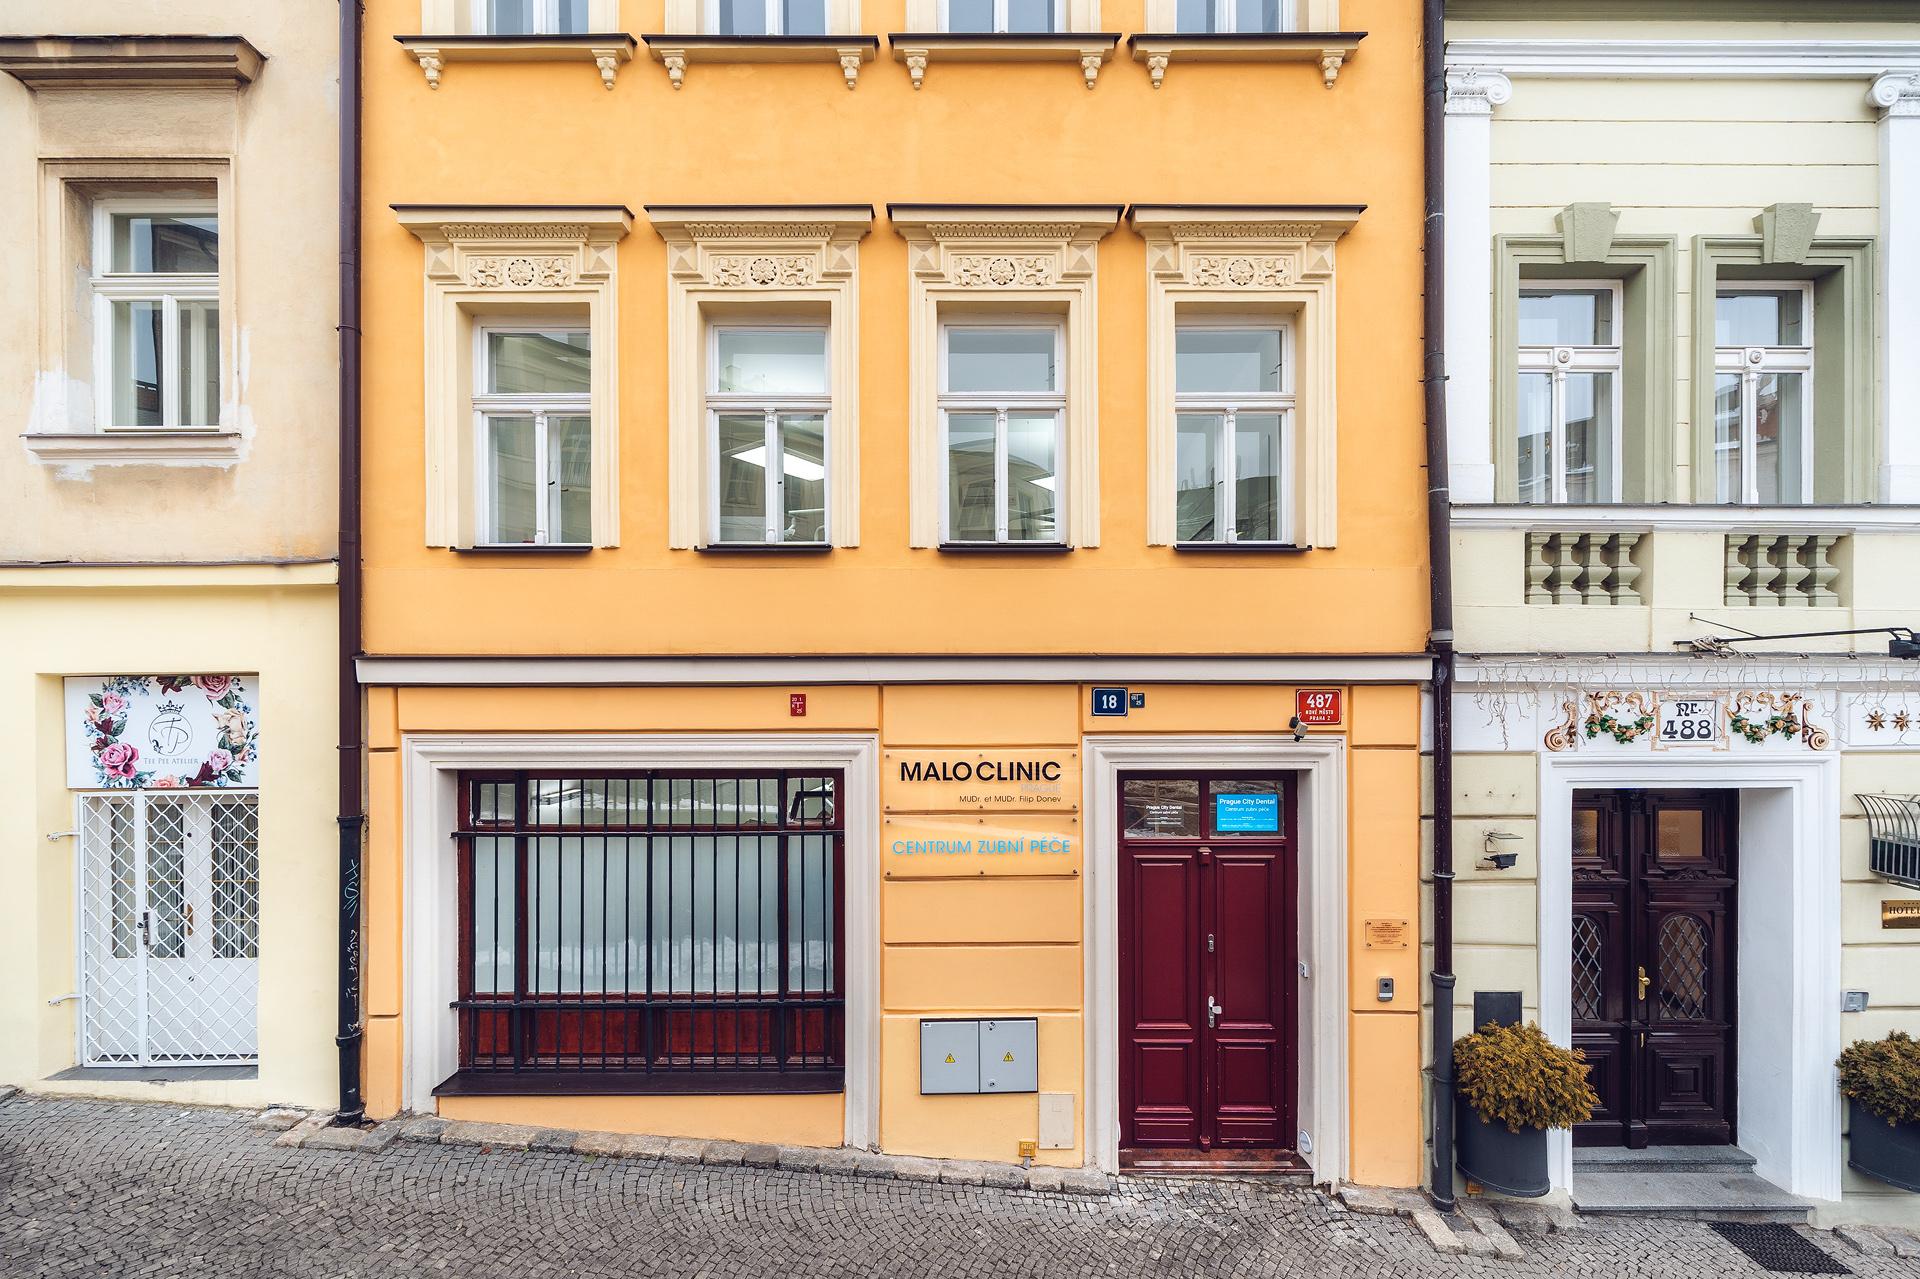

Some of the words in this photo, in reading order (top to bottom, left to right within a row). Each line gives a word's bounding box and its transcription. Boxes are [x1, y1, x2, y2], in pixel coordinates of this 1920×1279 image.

[1102, 695, 1117, 709] 18
[1306, 694, 1333, 708] 487
[1662, 719, 1712, 740] 488
[959, 795, 981, 803] MUDr.
[984, 795, 992, 803] et
[994, 795, 1017, 803] MUDr.
[1019, 795, 1034, 804] Filip
[1036, 795, 1061, 803] Donev
[1219, 798, 1241, 806] Prague
[1242, 798, 1255, 806] City
[892, 840, 972, 855] CENTRUM
[977, 837, 1024, 854] ZUBNÍ
[1030, 836, 1071, 853] PÉČE
